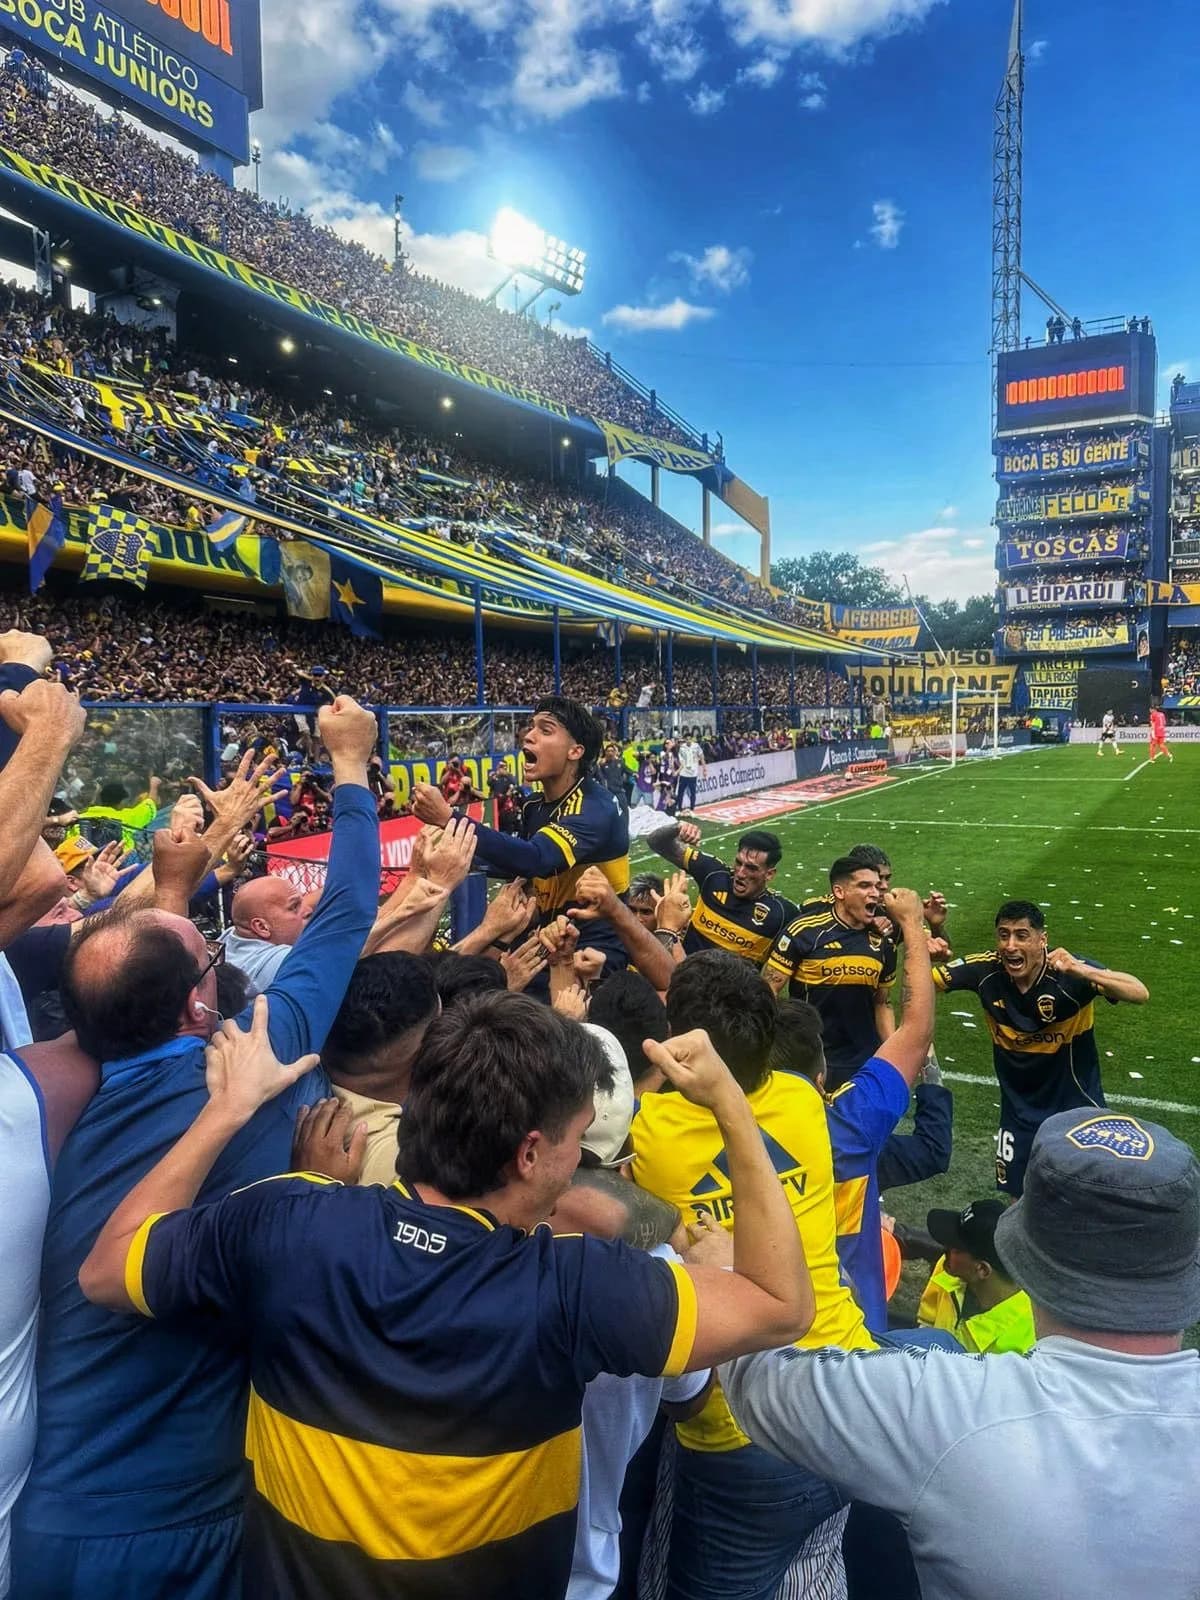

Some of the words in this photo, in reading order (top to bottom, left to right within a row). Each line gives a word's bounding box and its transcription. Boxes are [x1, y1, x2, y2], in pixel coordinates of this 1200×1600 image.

[93, 11, 199, 91] ATLÉTICO
[94, 39, 215, 129] JUNIORS
[1003, 453, 1039, 473] BOCA
[1042, 452, 1059, 470] ES
[1062, 448, 1080, 467] SU
[1083, 441, 1129, 464] GENTE
[1016, 533, 1119, 559] TOSCAS
[1016, 582, 1114, 605] LEOPARDI
[1151, 581, 1191, 604] LA
[833, 605, 919, 629] LAFERRERE
[934, 650, 991, 667] VISO
[1053, 670, 1078, 682] ROSA
[1031, 687, 1078, 698] TAPIALES
[1120, 731, 1147, 740] Banco
[695, 775, 718, 794] anco
[719, 768, 729, 788] de
[730, 762, 765, 785] Comercio
[386, 835, 417, 867] VID
[699, 911, 755, 950] betsson
[821, 963, 880, 979] betsson
[393, 1221, 448, 1254] 1905
